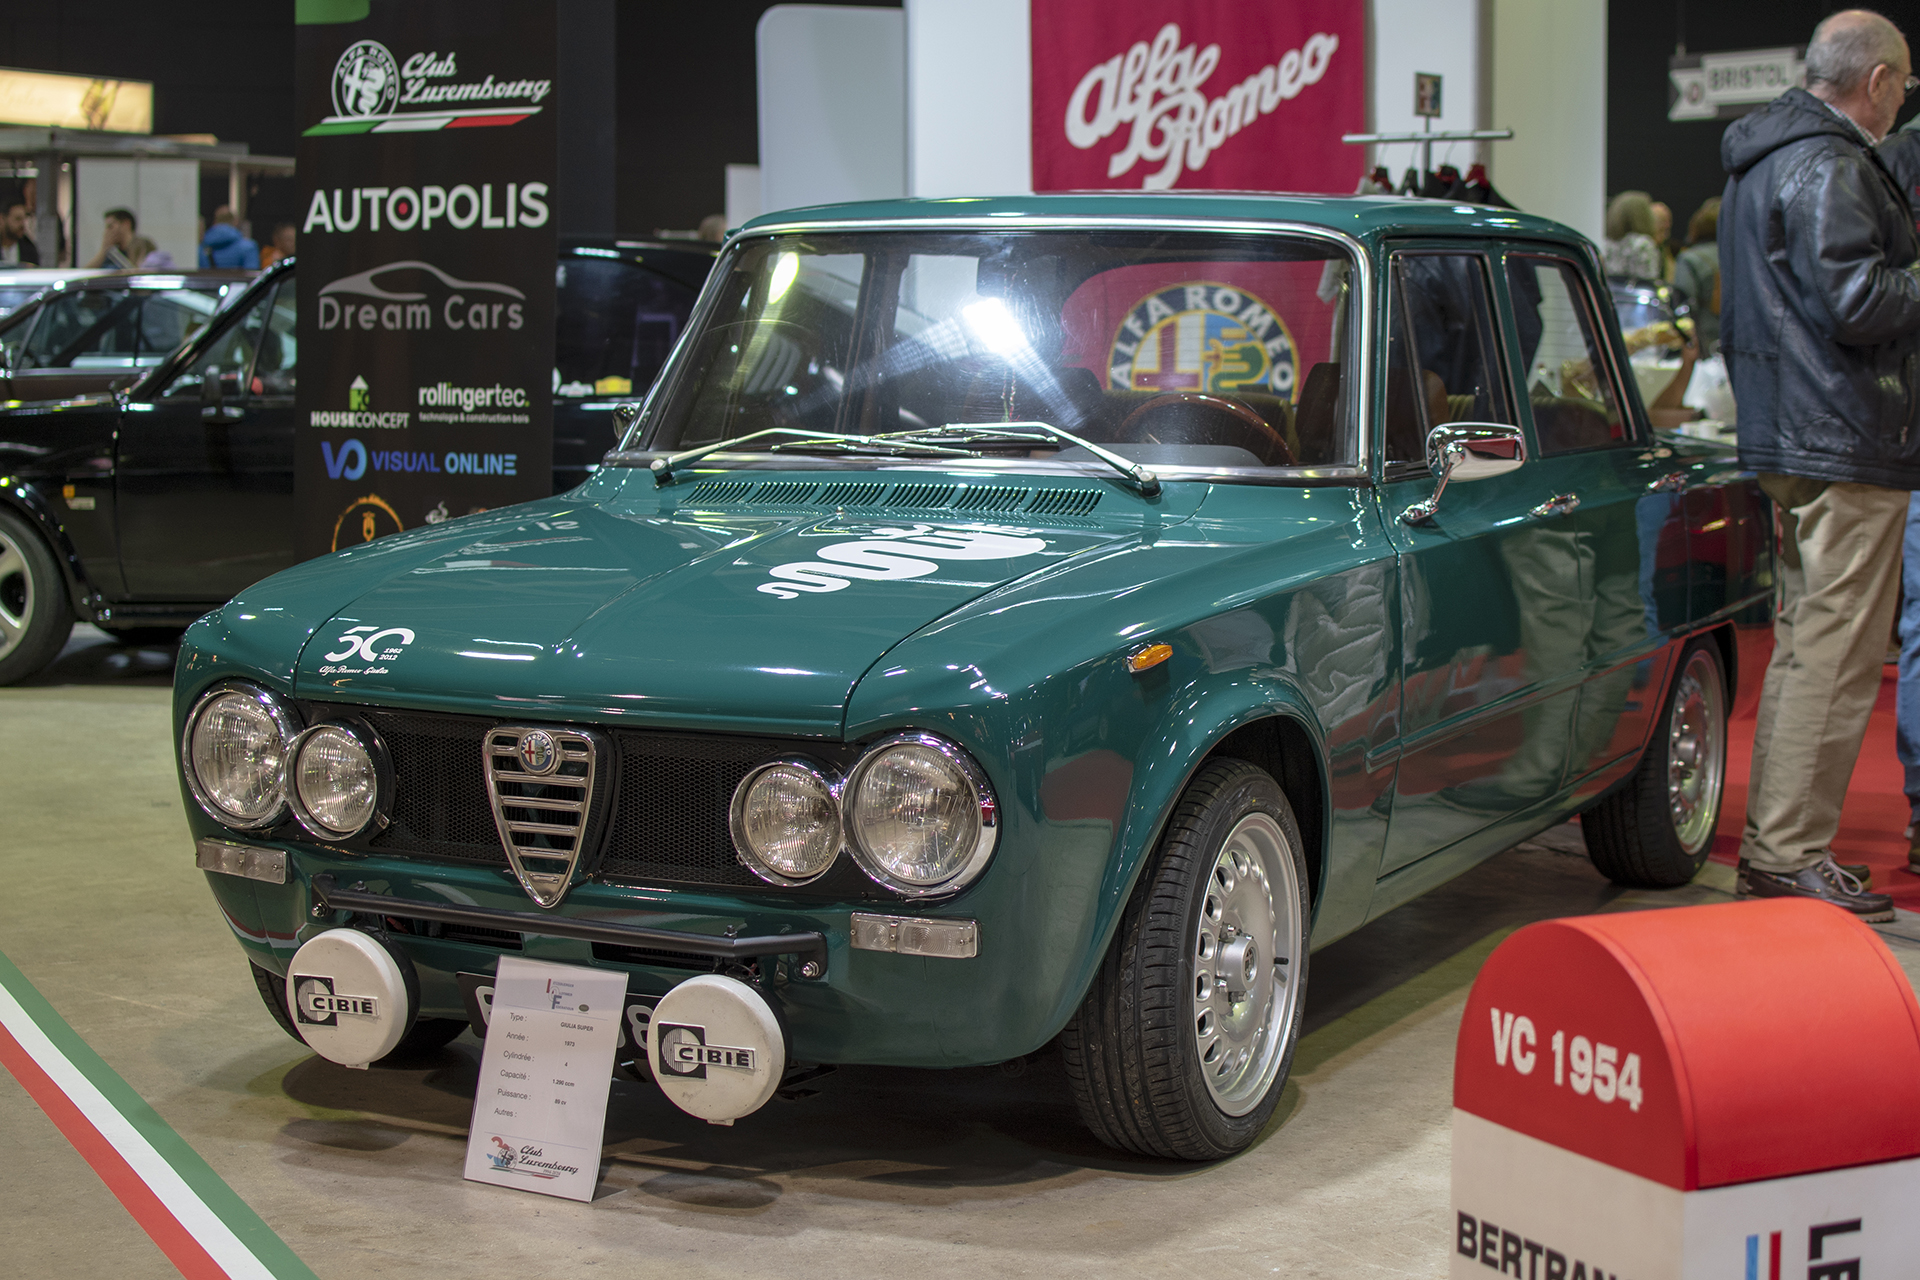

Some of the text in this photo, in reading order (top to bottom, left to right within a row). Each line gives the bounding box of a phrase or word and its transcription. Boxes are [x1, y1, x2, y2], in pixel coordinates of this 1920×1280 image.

[338, 46, 395, 100] ALFA ROMEO
[401, 52, 457, 79] Club
[1710, 64, 1790, 90] BRISTOL
[400, 75, 551, 103] Luxembourg
[1141, 32, 1340, 191] Romeo
[303, 182, 549, 233] AUTOPOLIS
[319, 295, 524, 330] Dream Cars
[1111, 284, 1295, 392] ALFA ROMEO
[372, 451, 441, 472] VISUAL
[445, 452, 517, 475] ONLINE
[510, 1012, 524, 1022] Type
[561, 1021, 594, 1032] GIULIA SUPER
[506, 1032, 526, 1041] Année
[503, 1050, 532, 1062] Cylindrée
[1490, 1007, 1643, 1112] VC 1954
[500, 1069, 527, 1081] Capacité
[497, 1088, 528, 1100] Puissance
[494, 1107, 513, 1117] Autres
[520, 1144, 543, 1157] Club
[518, 1154, 578, 1175] Luxembourg
